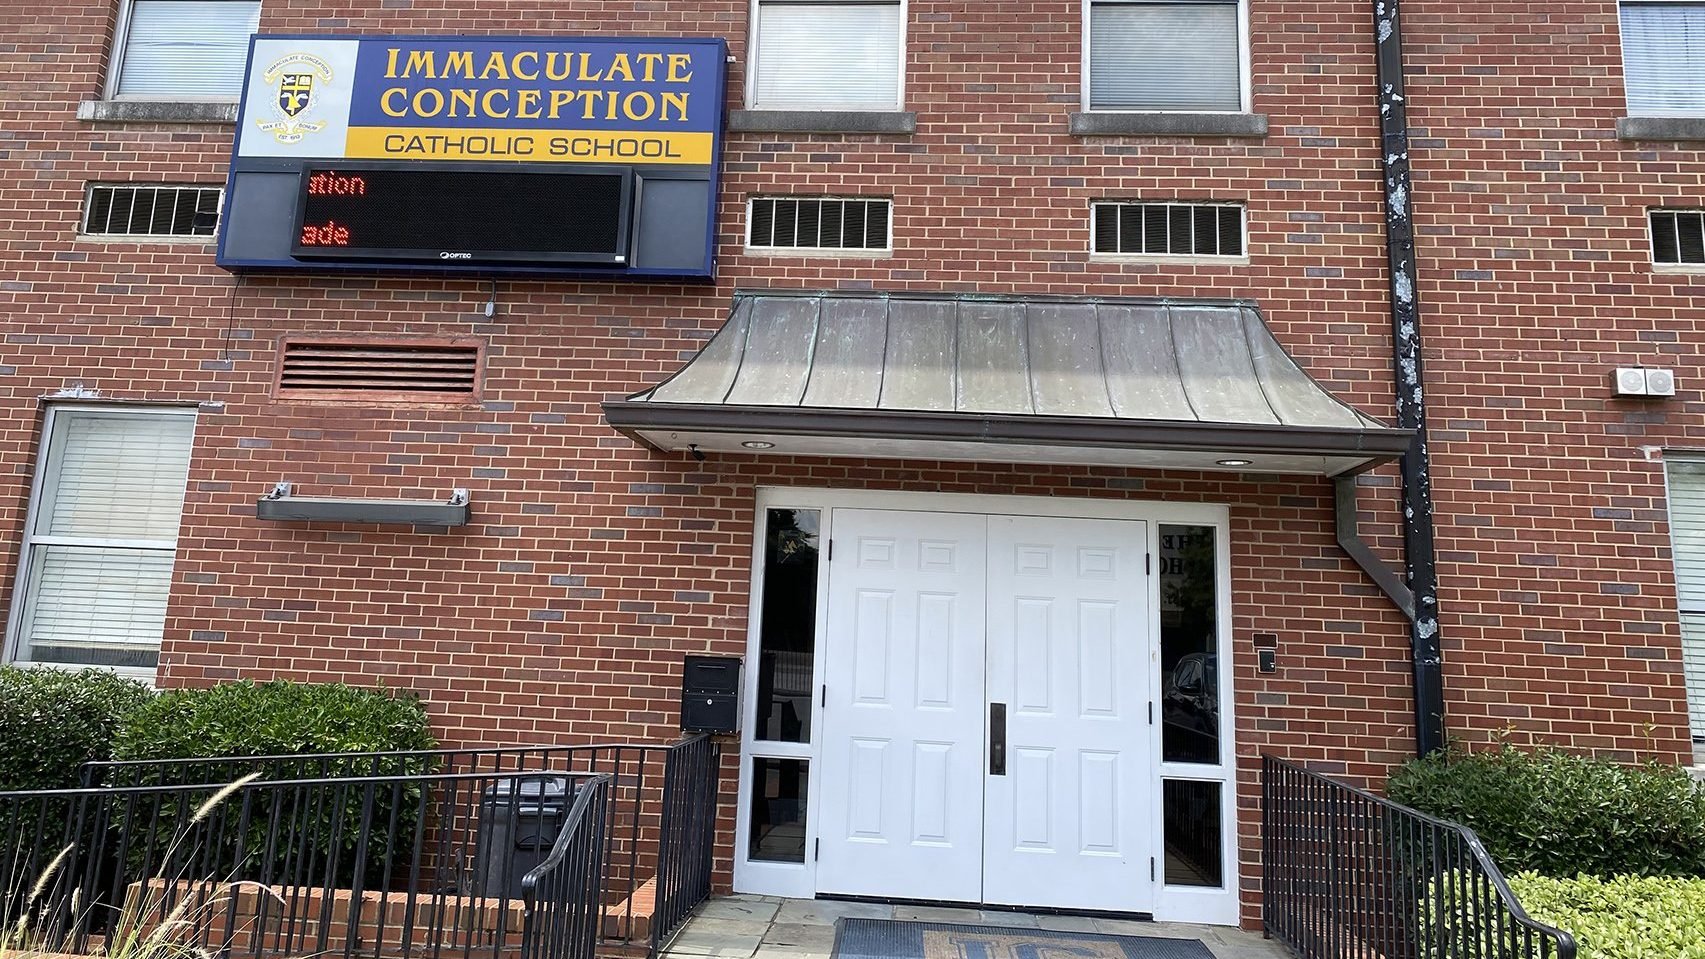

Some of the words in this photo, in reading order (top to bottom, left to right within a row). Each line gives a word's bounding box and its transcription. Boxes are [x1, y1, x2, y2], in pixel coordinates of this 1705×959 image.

[267, 55, 299, 74] IMMACULATE
[300, 55, 330, 75] CONCEPTION
[384, 48, 694, 83] IMMACULATE
[379, 87, 690, 121] CONCEPTION
[385, 135, 534, 155] CATHOLIC
[549, 137, 681, 158] SCHOOL
